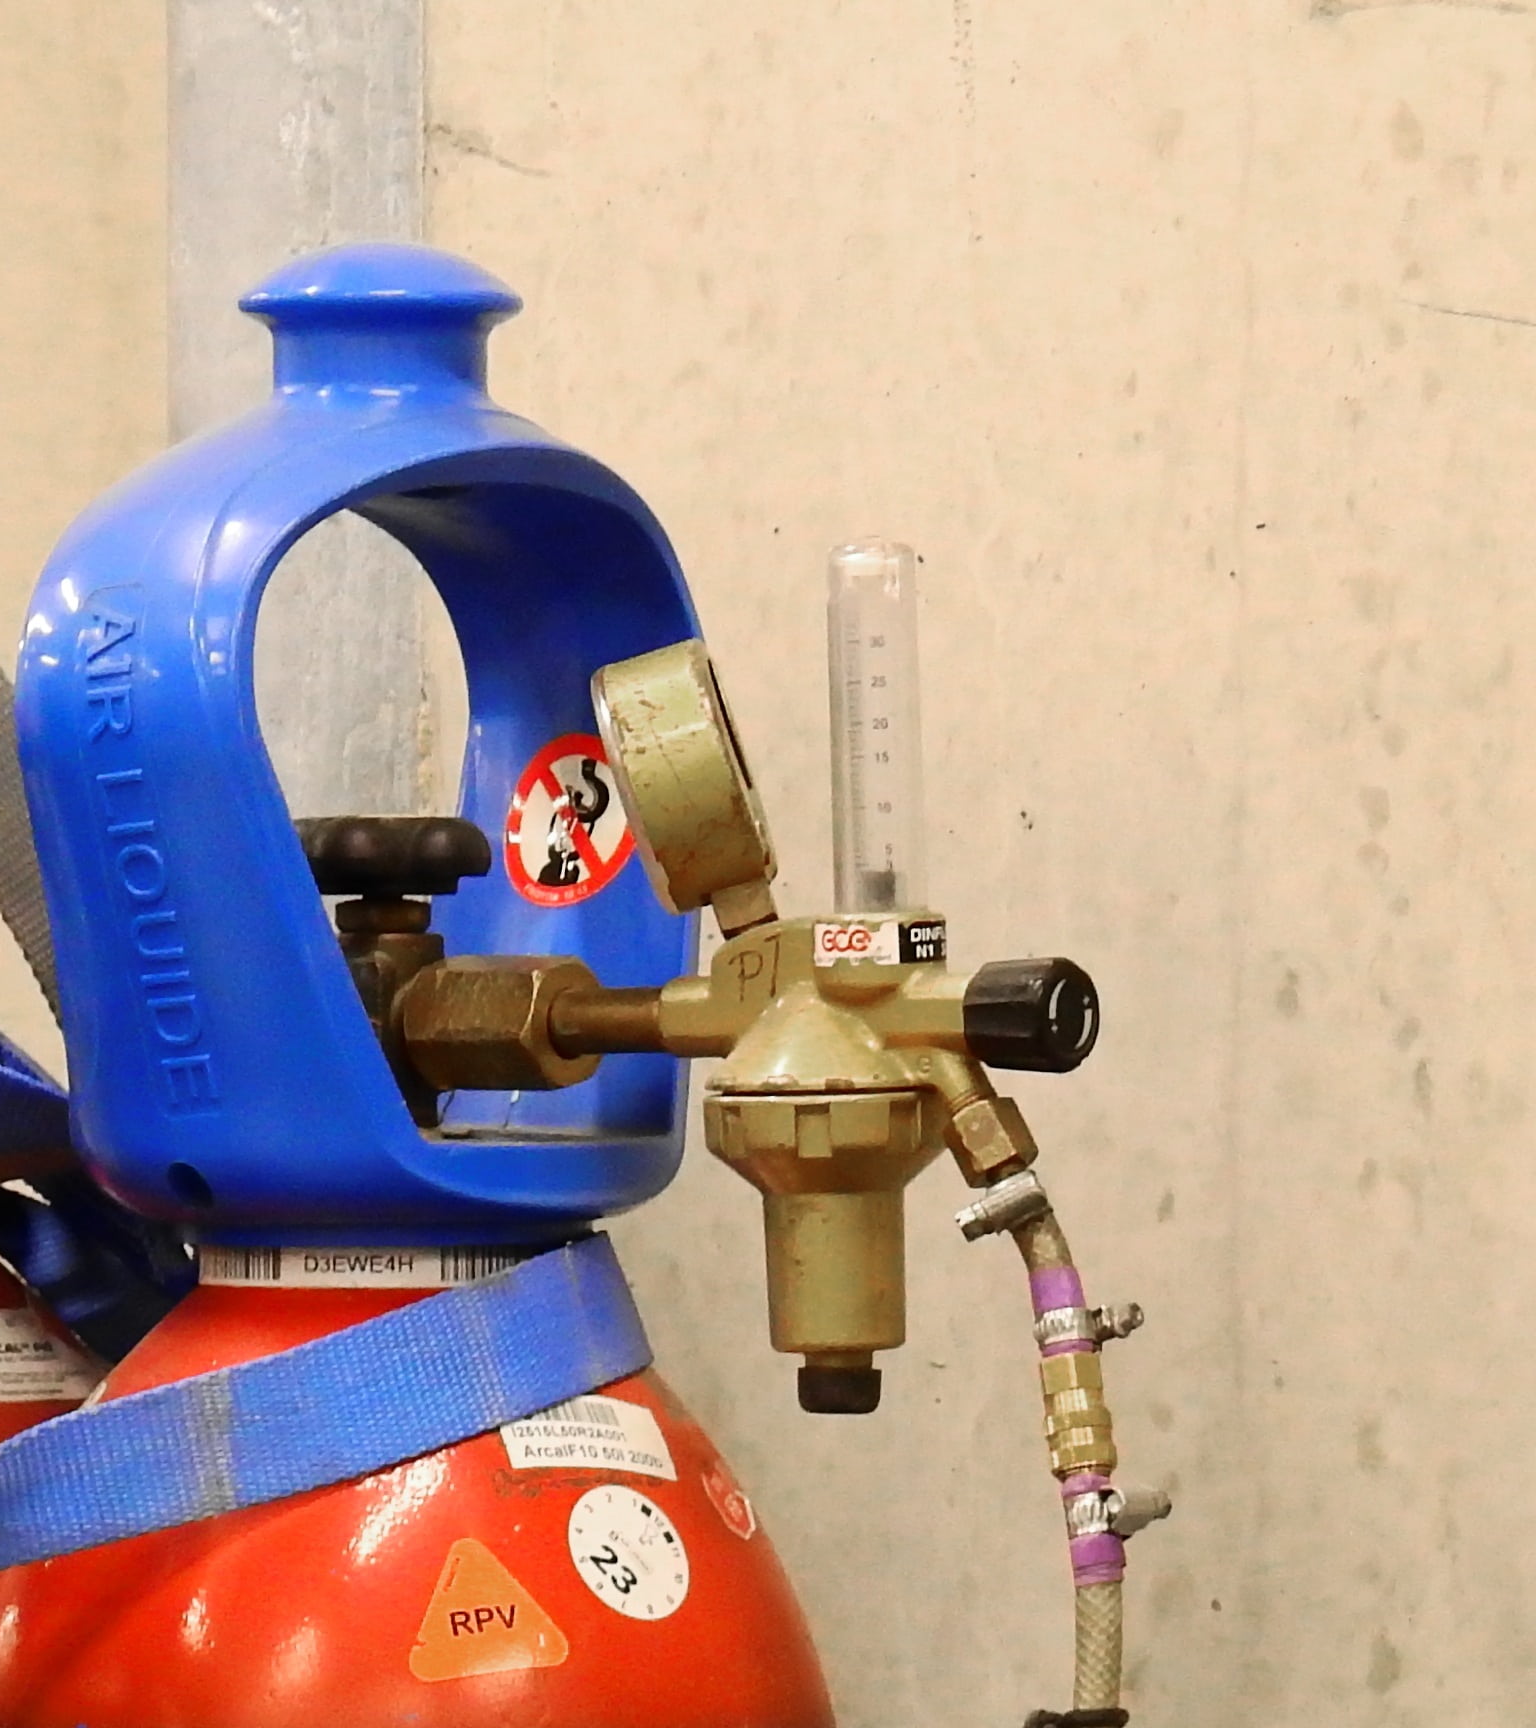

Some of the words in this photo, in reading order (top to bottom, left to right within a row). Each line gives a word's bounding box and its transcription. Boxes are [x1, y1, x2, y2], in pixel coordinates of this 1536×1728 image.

[86, 612, 137, 744] AIR
[302, 1251, 415, 1277] D3EWE4H
[589, 1543, 639, 1596] 23
[449, 1604, 516, 1637] RPV
